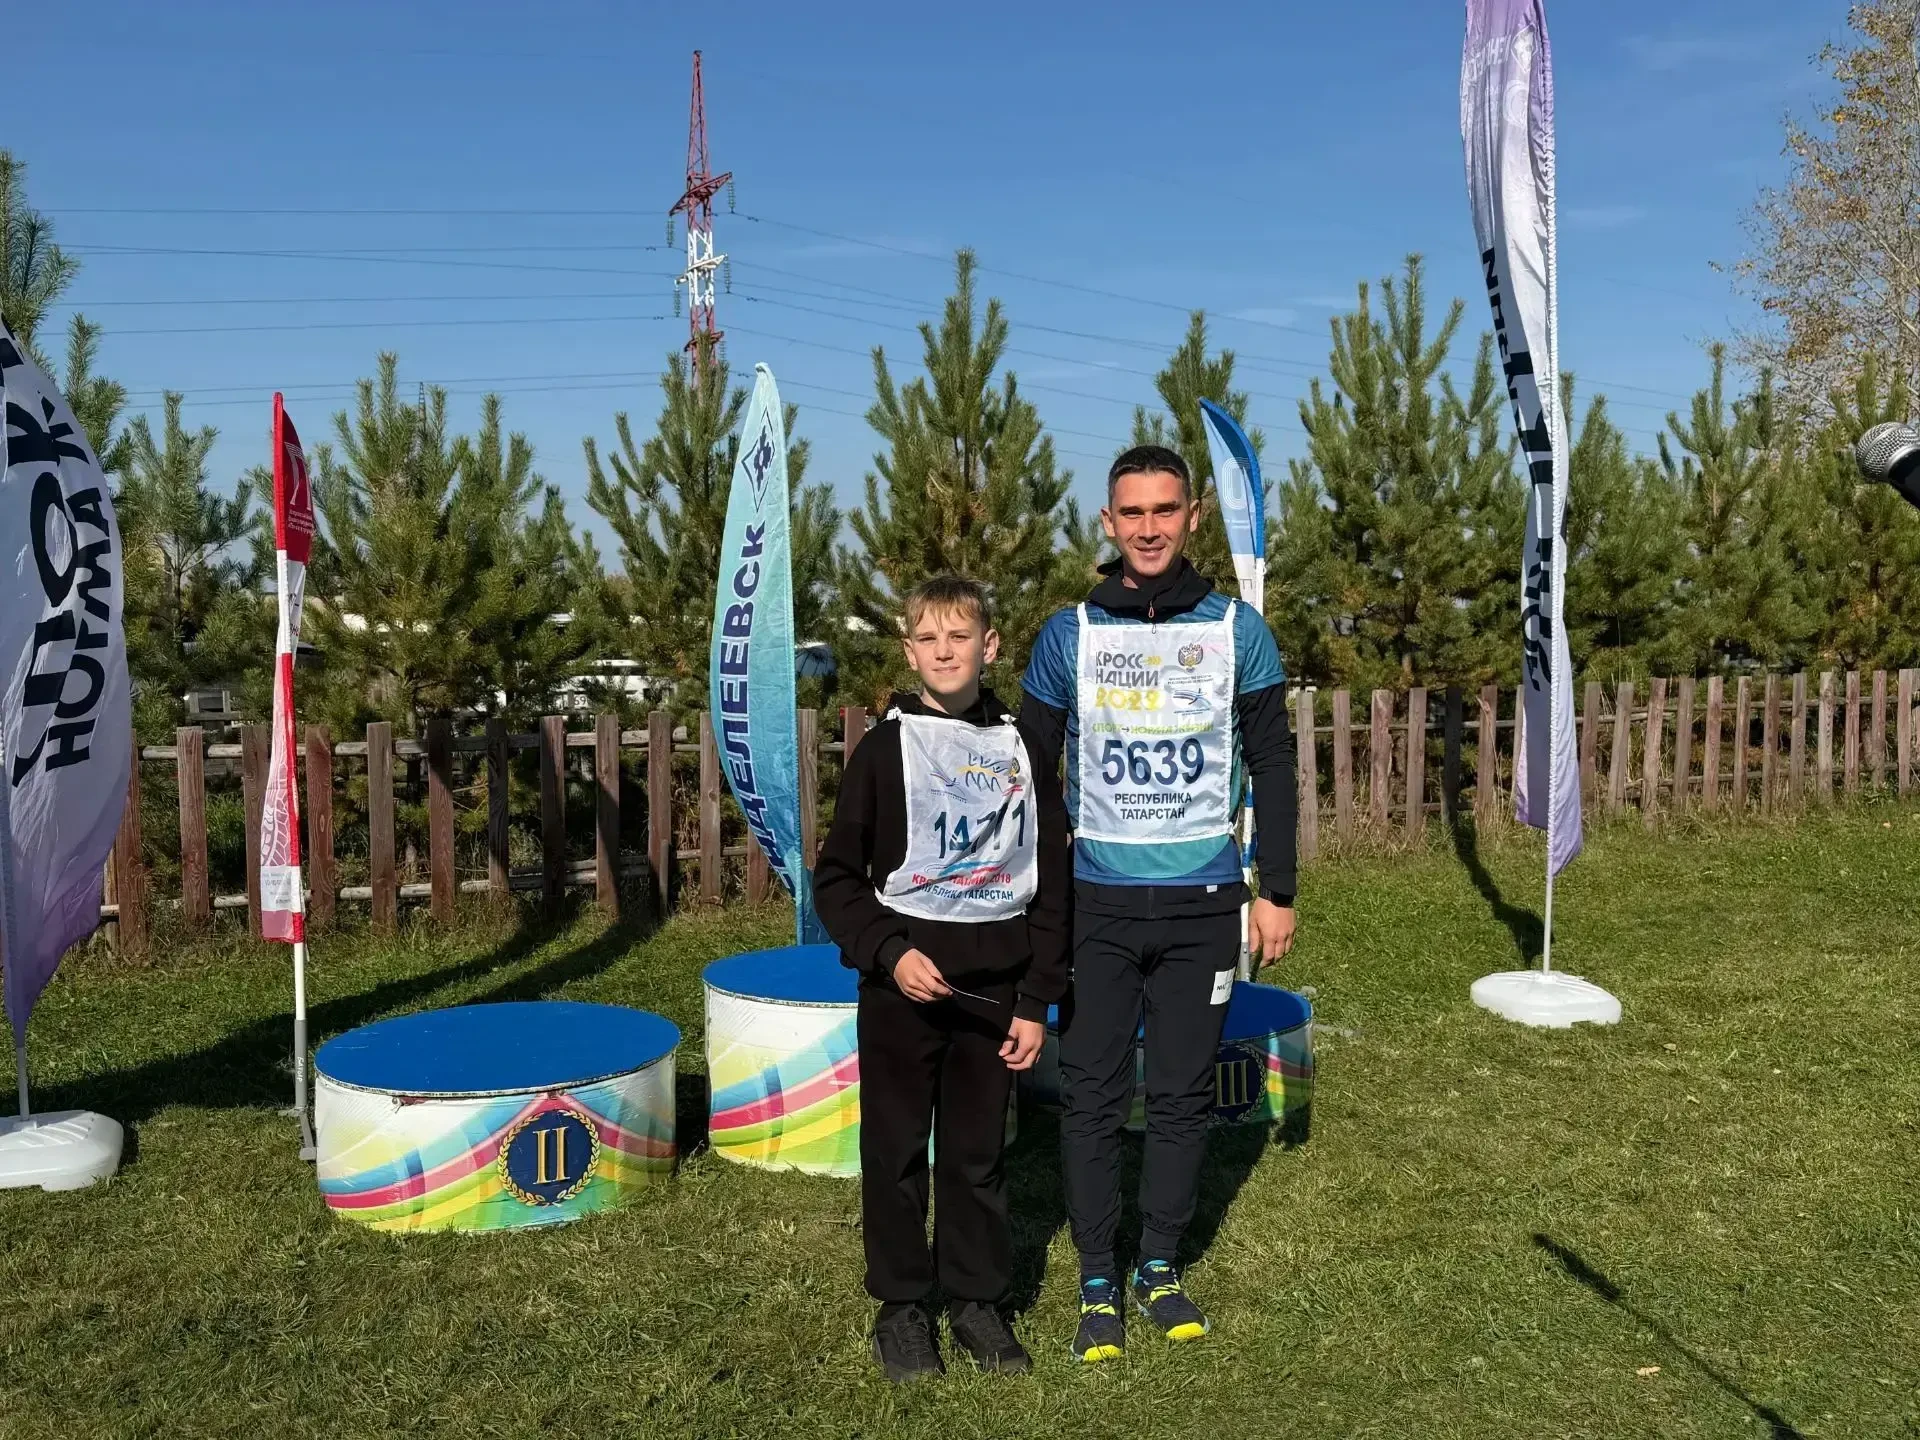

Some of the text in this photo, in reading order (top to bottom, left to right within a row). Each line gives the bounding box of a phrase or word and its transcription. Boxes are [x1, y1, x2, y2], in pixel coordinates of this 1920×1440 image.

[1096, 650, 1144, 669] КРОСС
[1096, 668, 1159, 688] НАЦИИ
[1101, 738, 1205, 786] 5639
[1114, 792, 1193, 805] РЕСПУБЛИКА
[1120, 807, 1185, 820] ТАТАРСТАН
[532, 1126, 571, 1185] II
